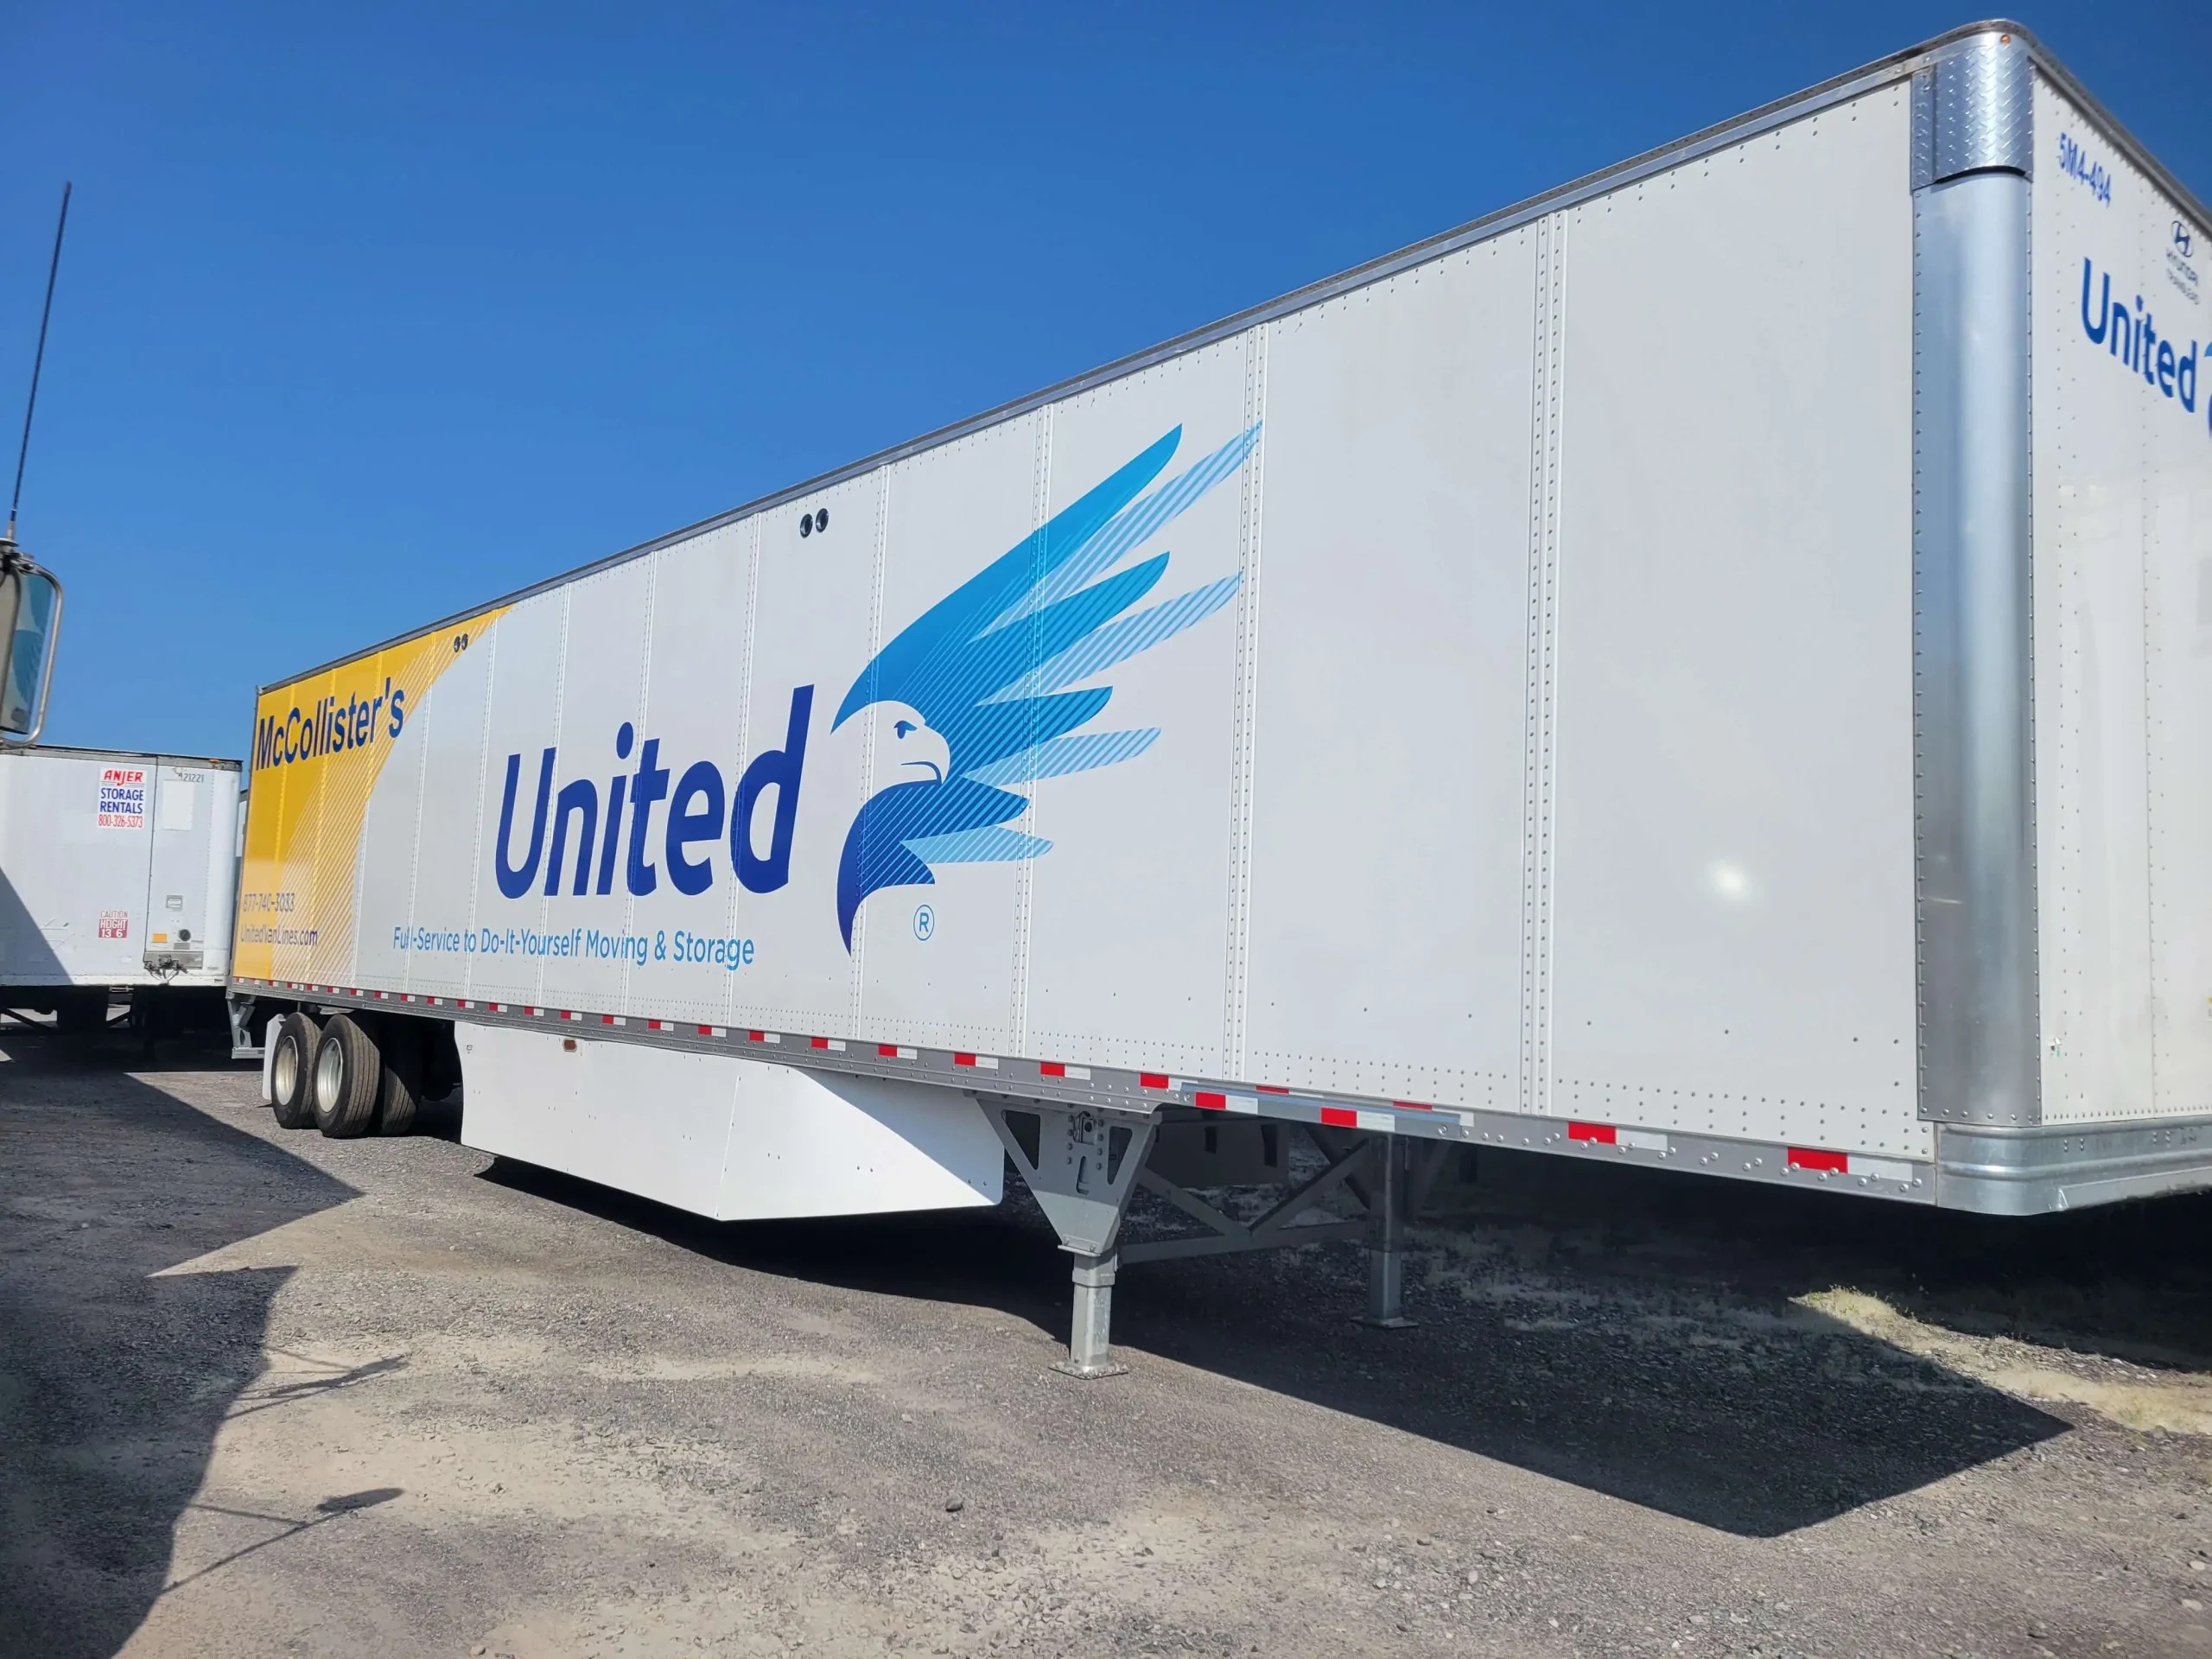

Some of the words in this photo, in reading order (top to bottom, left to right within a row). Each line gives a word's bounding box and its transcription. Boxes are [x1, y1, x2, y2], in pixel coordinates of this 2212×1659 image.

[2082, 257, 2197, 413] United
[256, 677, 404, 771] McCollister's
[104, 769, 143, 786] ANJER
[100, 787, 144, 801] STORAGE
[495, 684, 815, 899] United
[99, 800, 143, 814] RENTALS
[98, 814, 143, 828] 800-326-5373
[100, 910, 129, 918] CAUTION
[100, 918, 127, 930] HEIGHT
[392, 925, 460, 952] Full-Service
[464, 929, 476, 952] to
[480, 927, 582, 957] Do-It-Yourself
[586, 928, 649, 966] Moving
[655, 930, 666, 962] &
[673, 930, 755, 971] Storage
